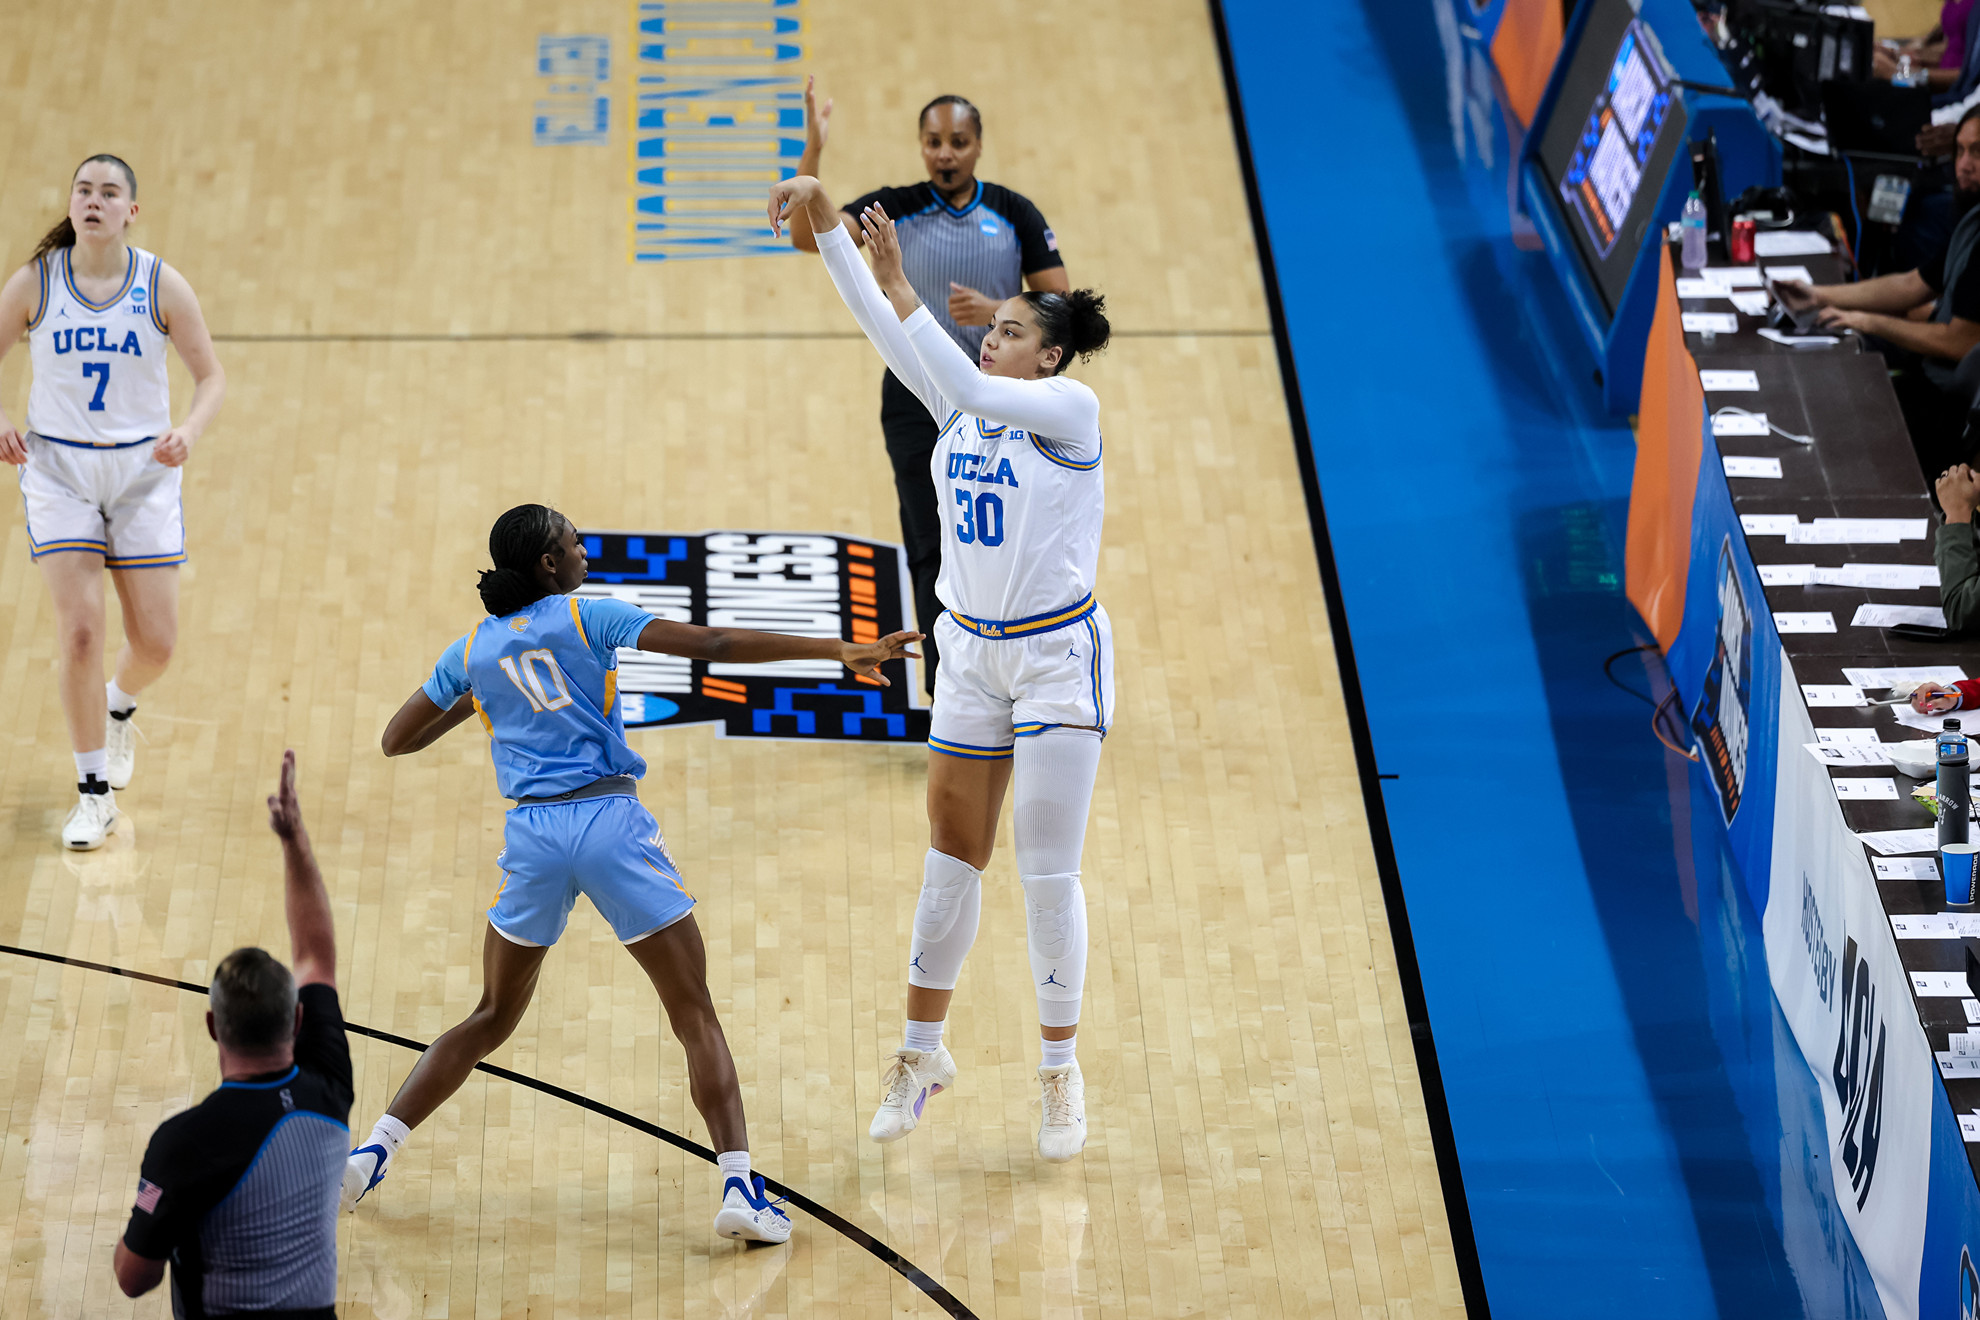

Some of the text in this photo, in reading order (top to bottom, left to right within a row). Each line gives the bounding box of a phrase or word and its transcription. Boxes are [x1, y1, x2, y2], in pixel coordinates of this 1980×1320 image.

[53, 327, 142, 357] UCLA
[82, 362, 110, 411] 7
[947, 452, 1019, 489] UCLA
[955, 488, 1004, 547] 30
[498, 648, 573, 713] 10
[1833, 918, 1886, 1214] UCLA
